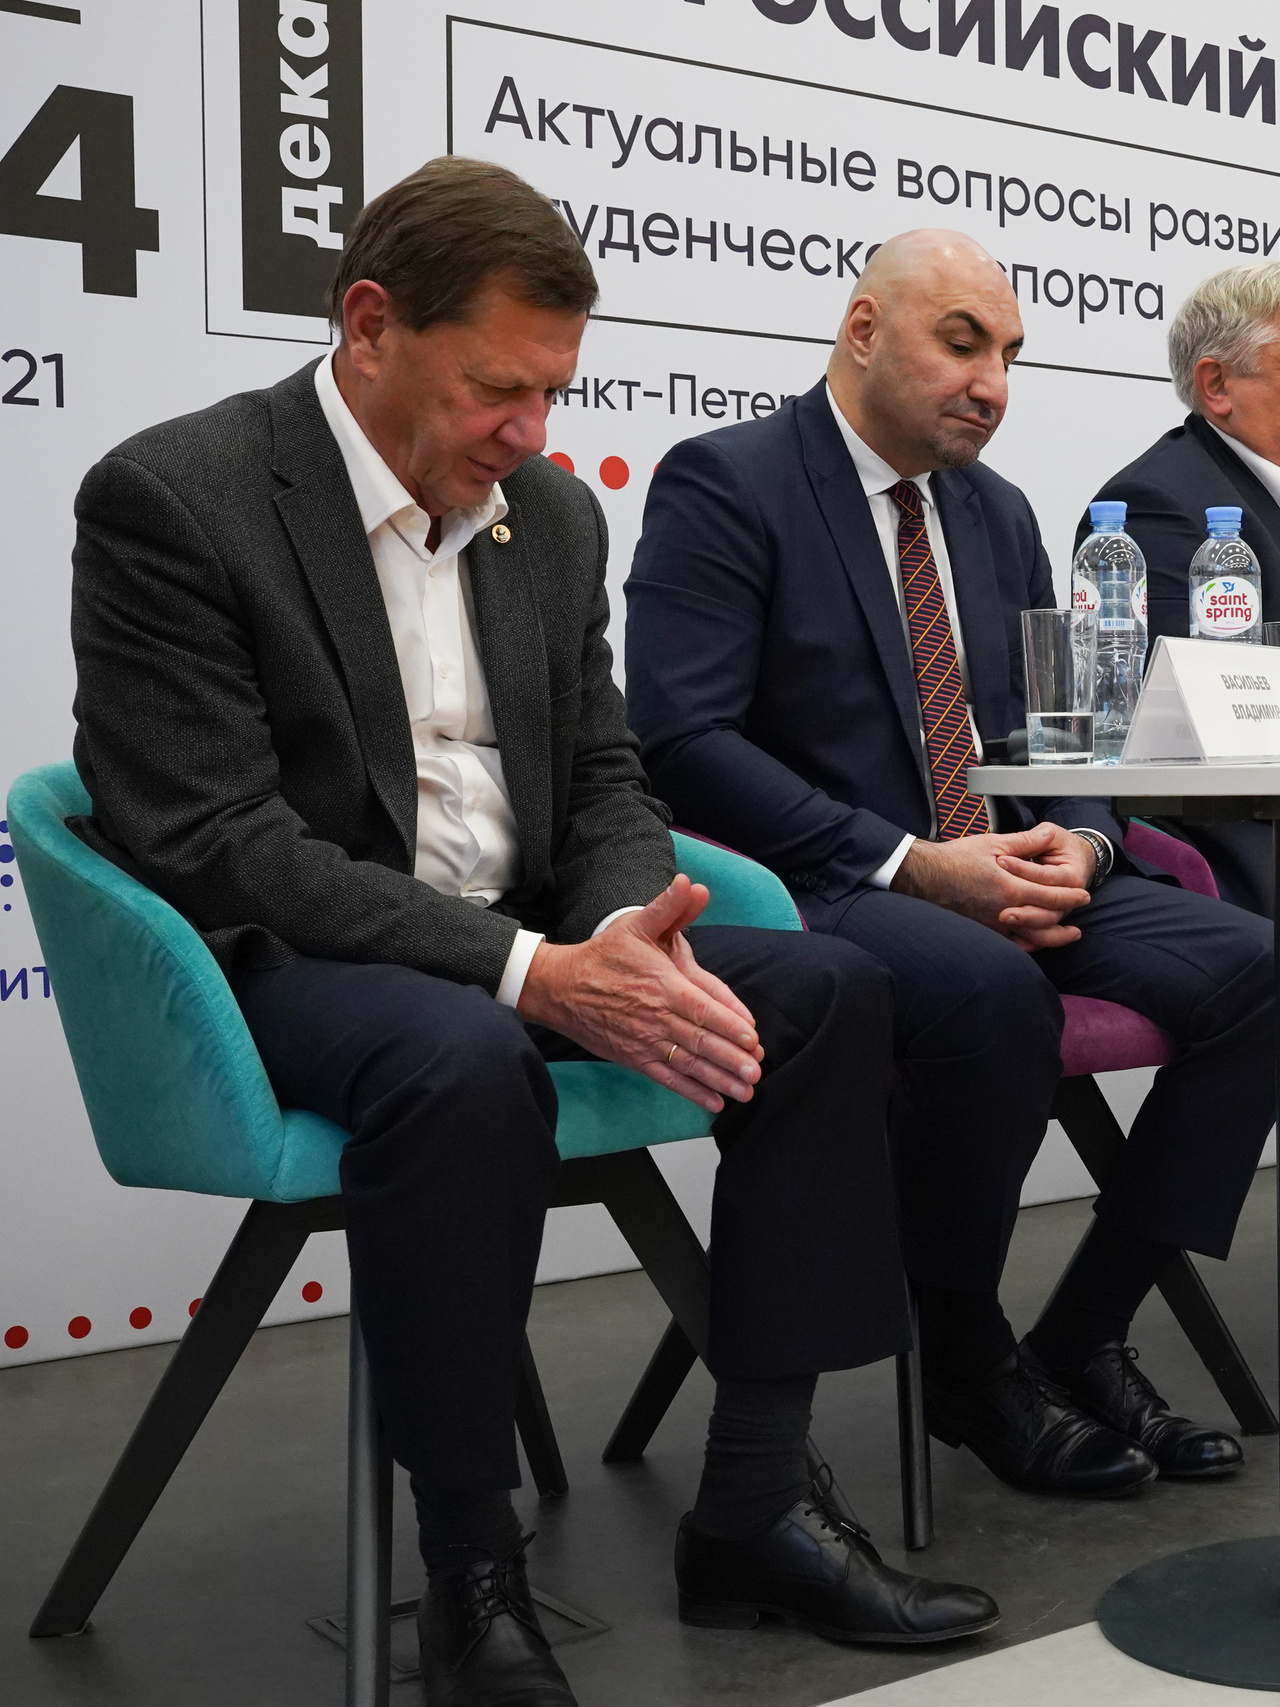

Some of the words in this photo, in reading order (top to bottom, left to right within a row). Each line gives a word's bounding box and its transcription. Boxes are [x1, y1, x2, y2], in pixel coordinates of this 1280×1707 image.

[484, 75, 877, 192] Актуальные
[897, 157, 1131, 234] вопросы
[550, 198, 884, 279] уденческ
[995, 259, 1164, 324] порта
[552, 372, 802, 421] нкт-Пете
[1210, 592, 1248, 606] saint
[1205, 607, 1252, 622] spring
[1220, 674, 1271, 691] ВАСИЛЬЕВ
[1231, 704, 1280, 723] ВЛАДИМИР
